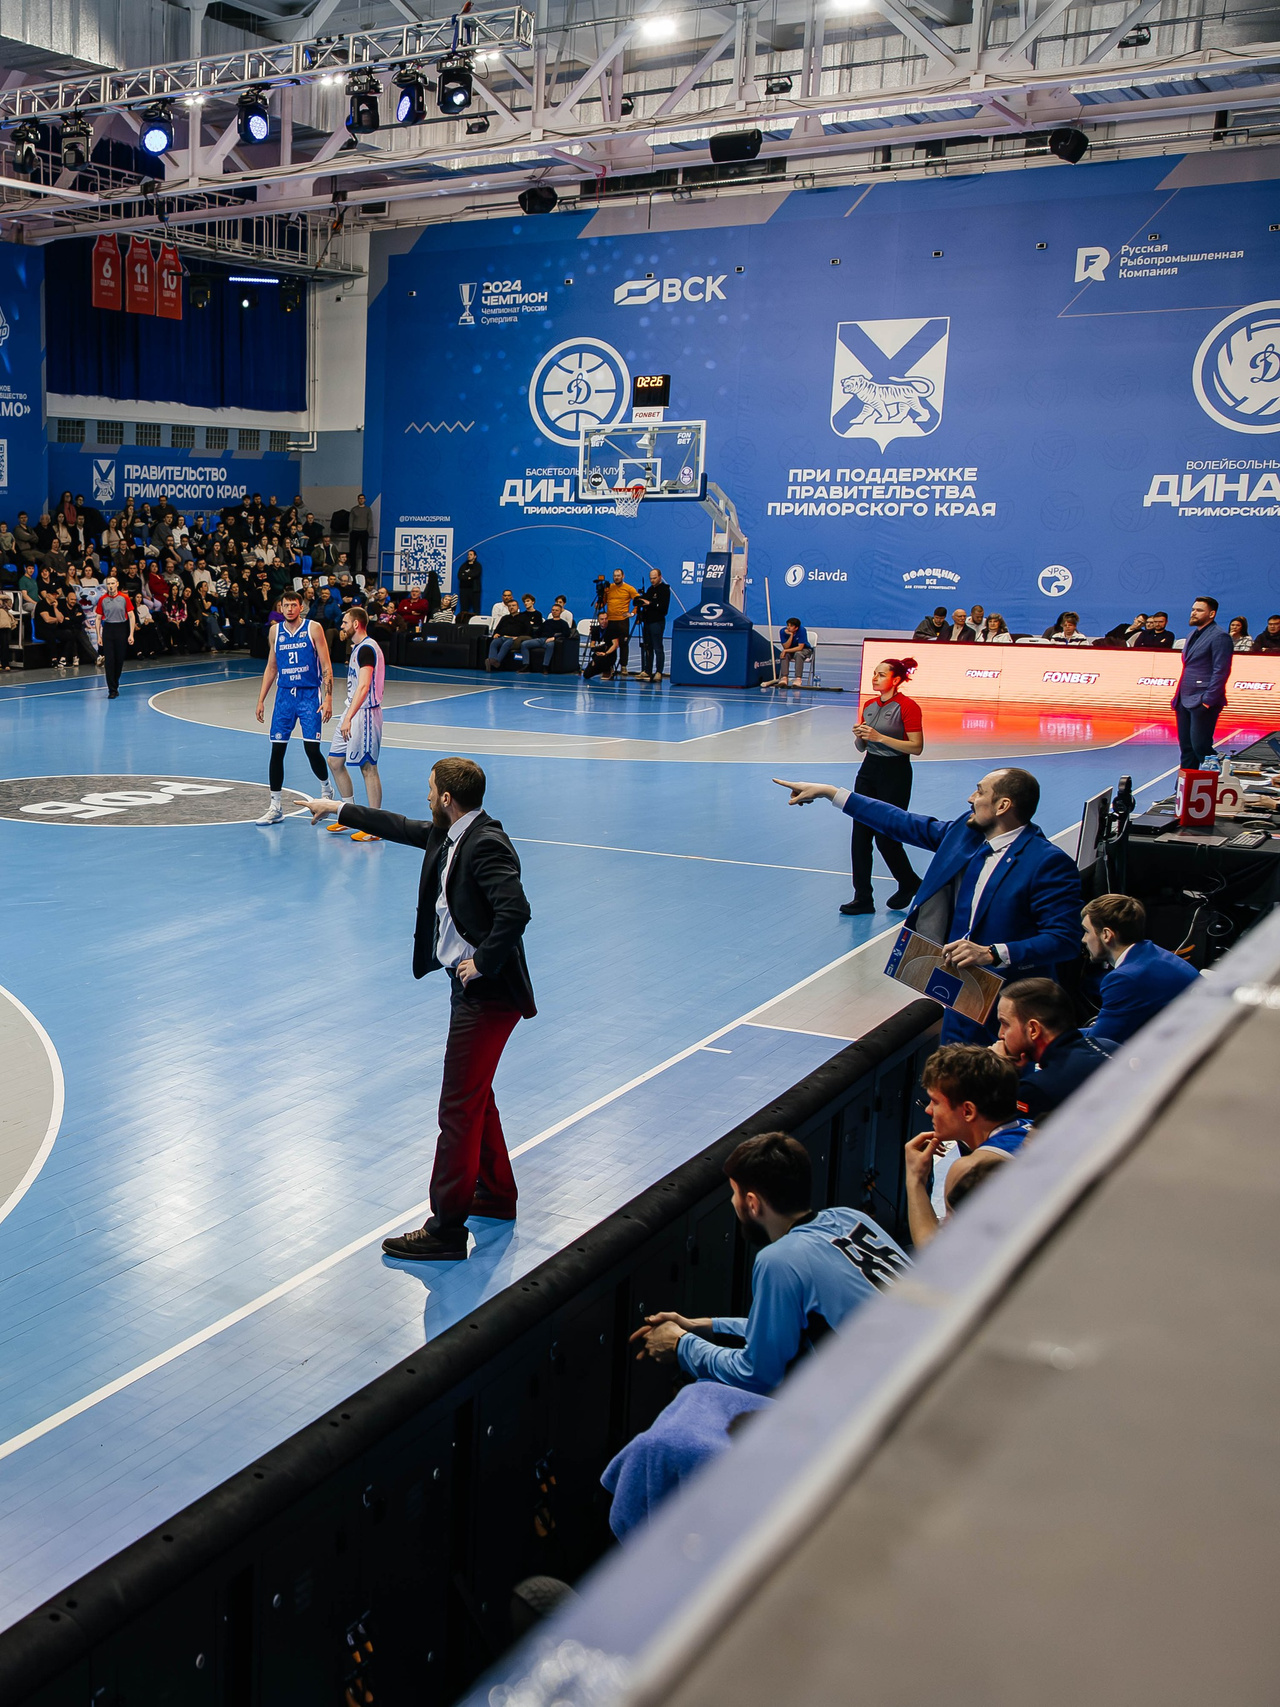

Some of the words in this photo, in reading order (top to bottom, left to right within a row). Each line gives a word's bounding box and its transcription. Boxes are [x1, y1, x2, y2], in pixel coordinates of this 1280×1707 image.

[1121, 244, 1169, 257] Русская
[1120, 250, 1244, 267] Рыбопромышленная
[102, 257, 112, 279] 6
[134, 263, 148, 285] 11
[1119, 267, 1178, 279] Компания
[161, 268, 177, 290] 10
[482, 279, 522, 294] 2024
[662, 274, 728, 304] ВСК
[482, 291, 548, 306] ЧЕМПИОН
[481, 306, 520, 315] Чемпионат
[522, 305, 548, 313] России
[481, 316, 518, 325] Суперлига
[634, 411, 661, 419] FONBET
[124, 464, 227, 482] ПРАВИТЕЛЬСТВО
[788, 469, 831, 483] ПРИ
[836, 467, 978, 485] ПОДДЕРЖКЕ
[123, 483, 214, 499] ПРИМОРСКОГО
[216, 484, 247, 499] КРАЯ
[786, 484, 977, 500] ПРАВИТЕЛЬСТВА
[524, 505, 593, 515] ПРИМОРСКИЙ
[767, 502, 929, 517] ПРИМОРСКОГО
[934, 502, 997, 517] КРАЯ
[1178, 505, 1280, 517] ПРИМОРСКИЙ
[705, 571, 724, 579] BET
[706, 564, 725, 572] FON
[808, 568, 848, 582] slavda
[279, 641, 308, 651] ДИНАМО
[288, 651, 298, 664] 21
[965, 669, 1002, 679] FONBET
[1042, 671, 1100, 684] FONBET
[1137, 677, 1177, 686] FONBET
[1233, 681, 1275, 691] FONBET
[1175, 776, 1185, 817] 5
[1188, 779, 1212, 819] 5
